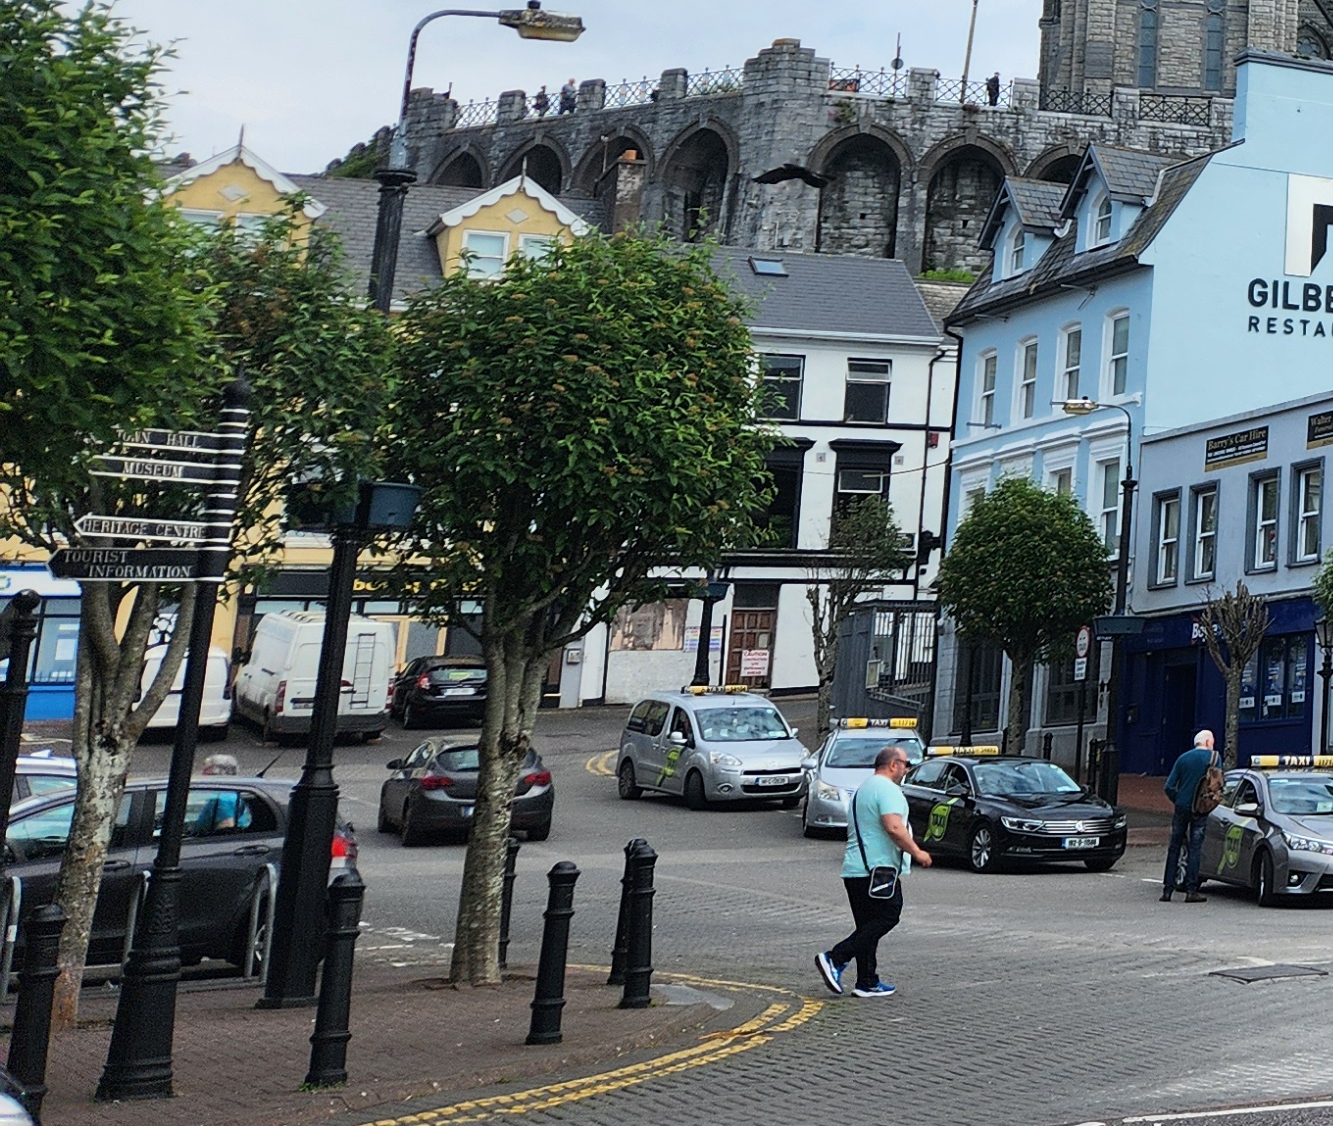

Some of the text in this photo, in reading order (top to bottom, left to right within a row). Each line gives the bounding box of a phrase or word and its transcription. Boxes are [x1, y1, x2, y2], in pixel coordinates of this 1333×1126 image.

[1311, 415, 1332, 427] Walter
[166, 433, 200, 448] HALL
[1207, 428, 1267, 451] Barry's Car Hire
[122, 461, 184, 478] MUSEUM
[81, 518, 207, 539] HERITAGE CENTRE
[64, 550, 129, 563] TOURIST
[88, 565, 193, 578] INFORMATION
[870, 718, 888, 726] TAXI
[1282, 755, 1311, 766] TAXI
